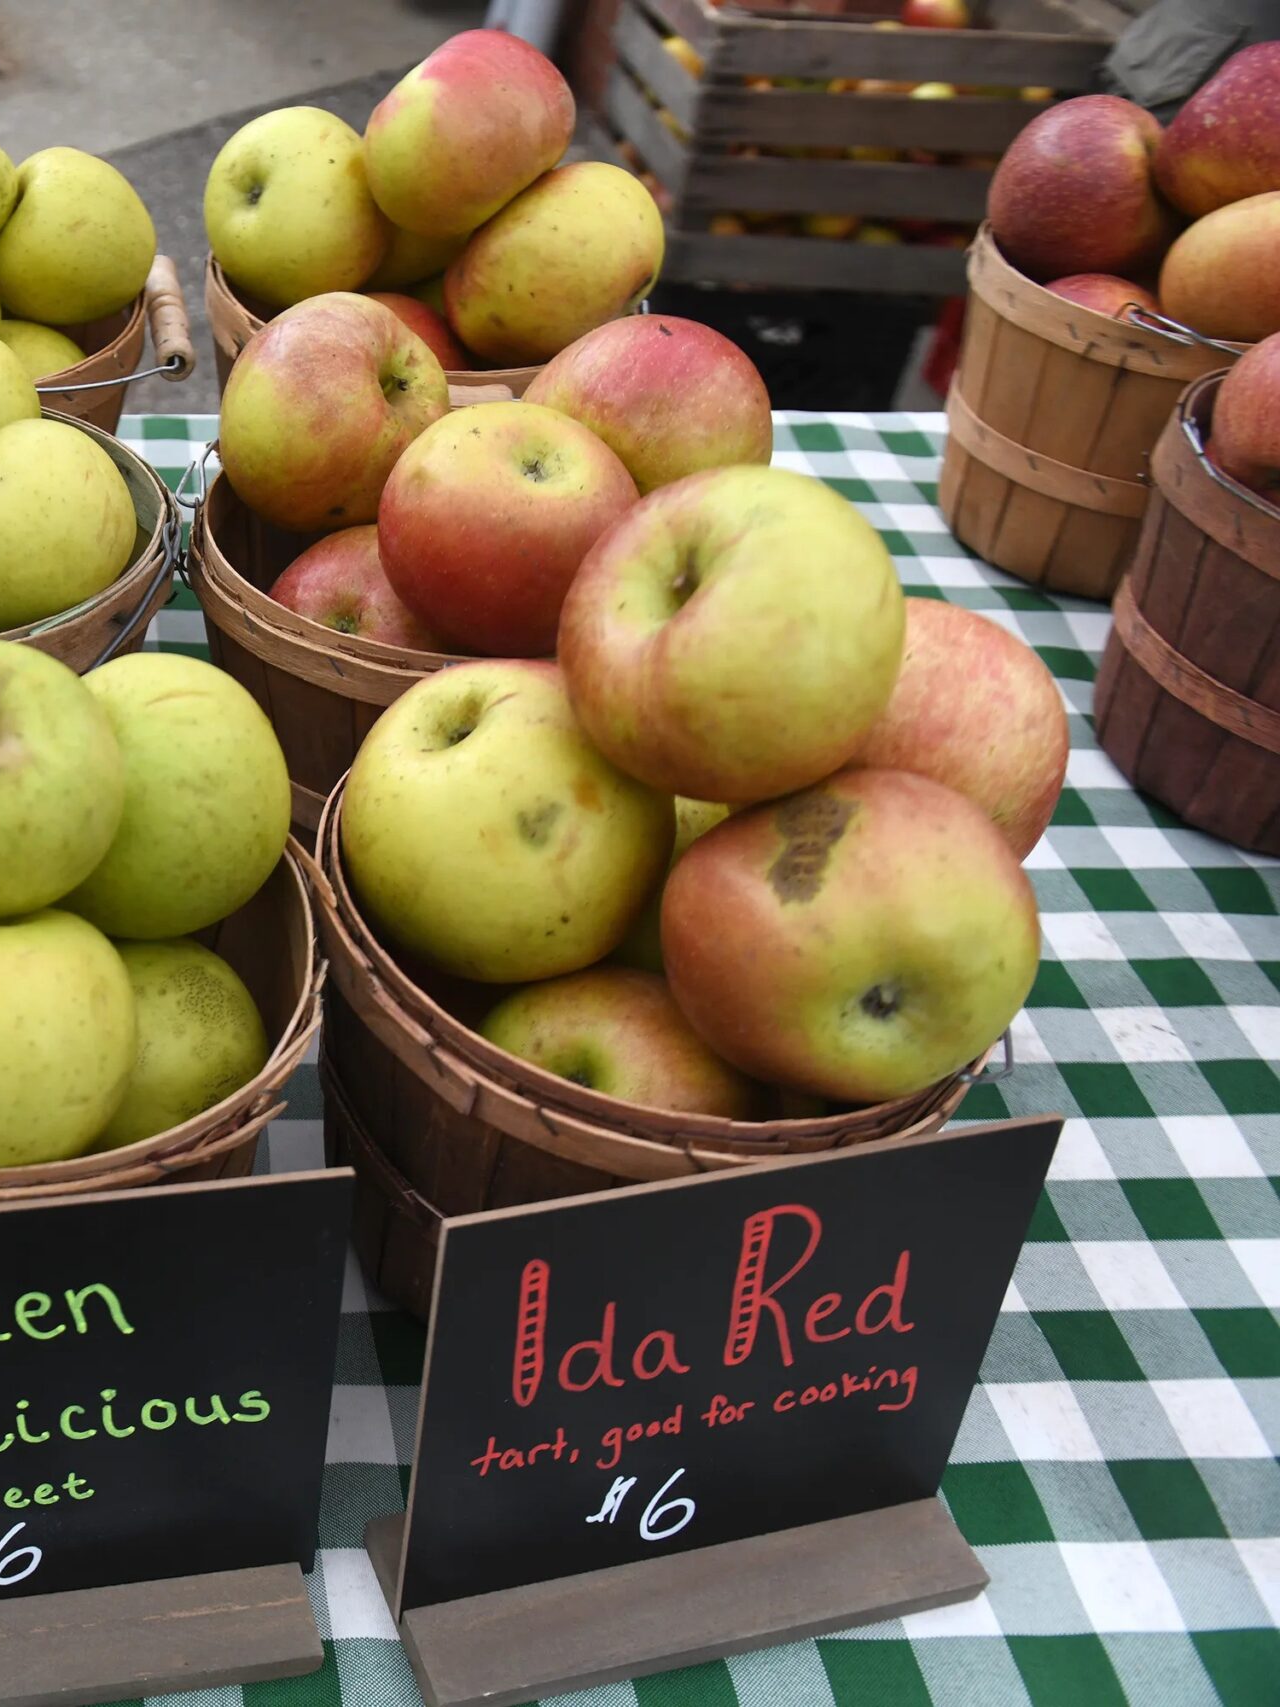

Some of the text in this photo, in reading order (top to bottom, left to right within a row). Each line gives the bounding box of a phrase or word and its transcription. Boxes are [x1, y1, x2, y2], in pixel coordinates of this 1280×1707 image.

[512, 1203, 916, 1407] Ida Red
[471, 1365, 919, 1476] tart, good for cooking
